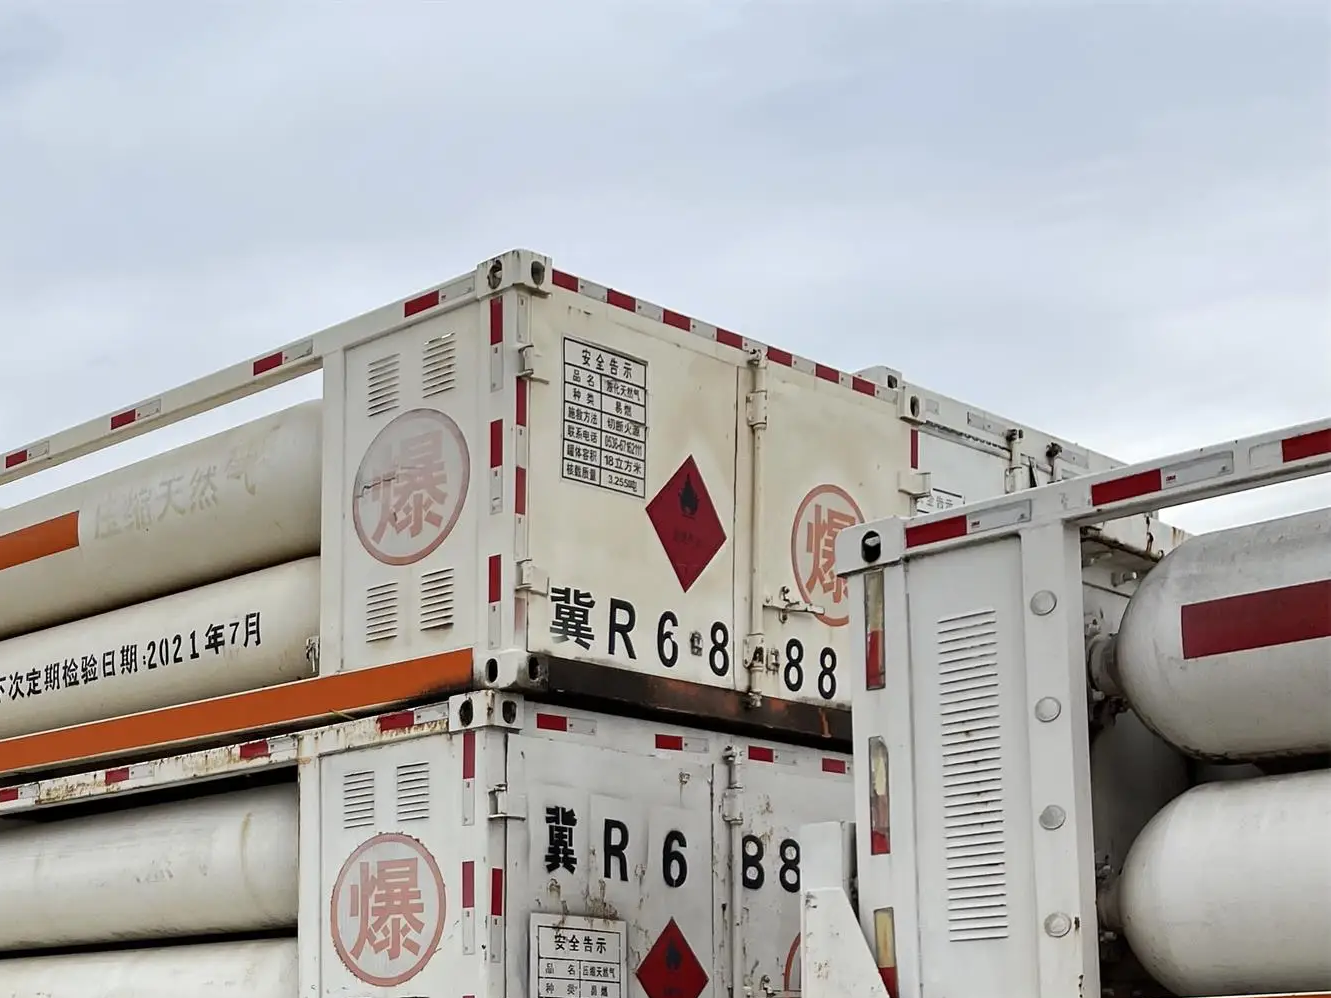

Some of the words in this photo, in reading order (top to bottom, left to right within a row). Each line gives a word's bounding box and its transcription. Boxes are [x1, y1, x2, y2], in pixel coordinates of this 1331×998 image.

[582, 348, 632, 379] 安全告示
[573, 369, 595, 387] 品名
[573, 388, 595, 406] 种类
[568, 406, 598, 425] 施救方法
[567, 425, 598, 443] 联系电话
[567, 444, 597, 462] 罐体容积
[604, 455, 642, 474] 18立方米
[371, 429, 448, 544] 爆
[608, 475, 638, 492] 3.255吨
[804, 504, 856, 604] 爆
[349, 857, 426, 961] 爆
[554, 934, 607, 954] 安全告示
[545, 962, 576, 976] 品名
